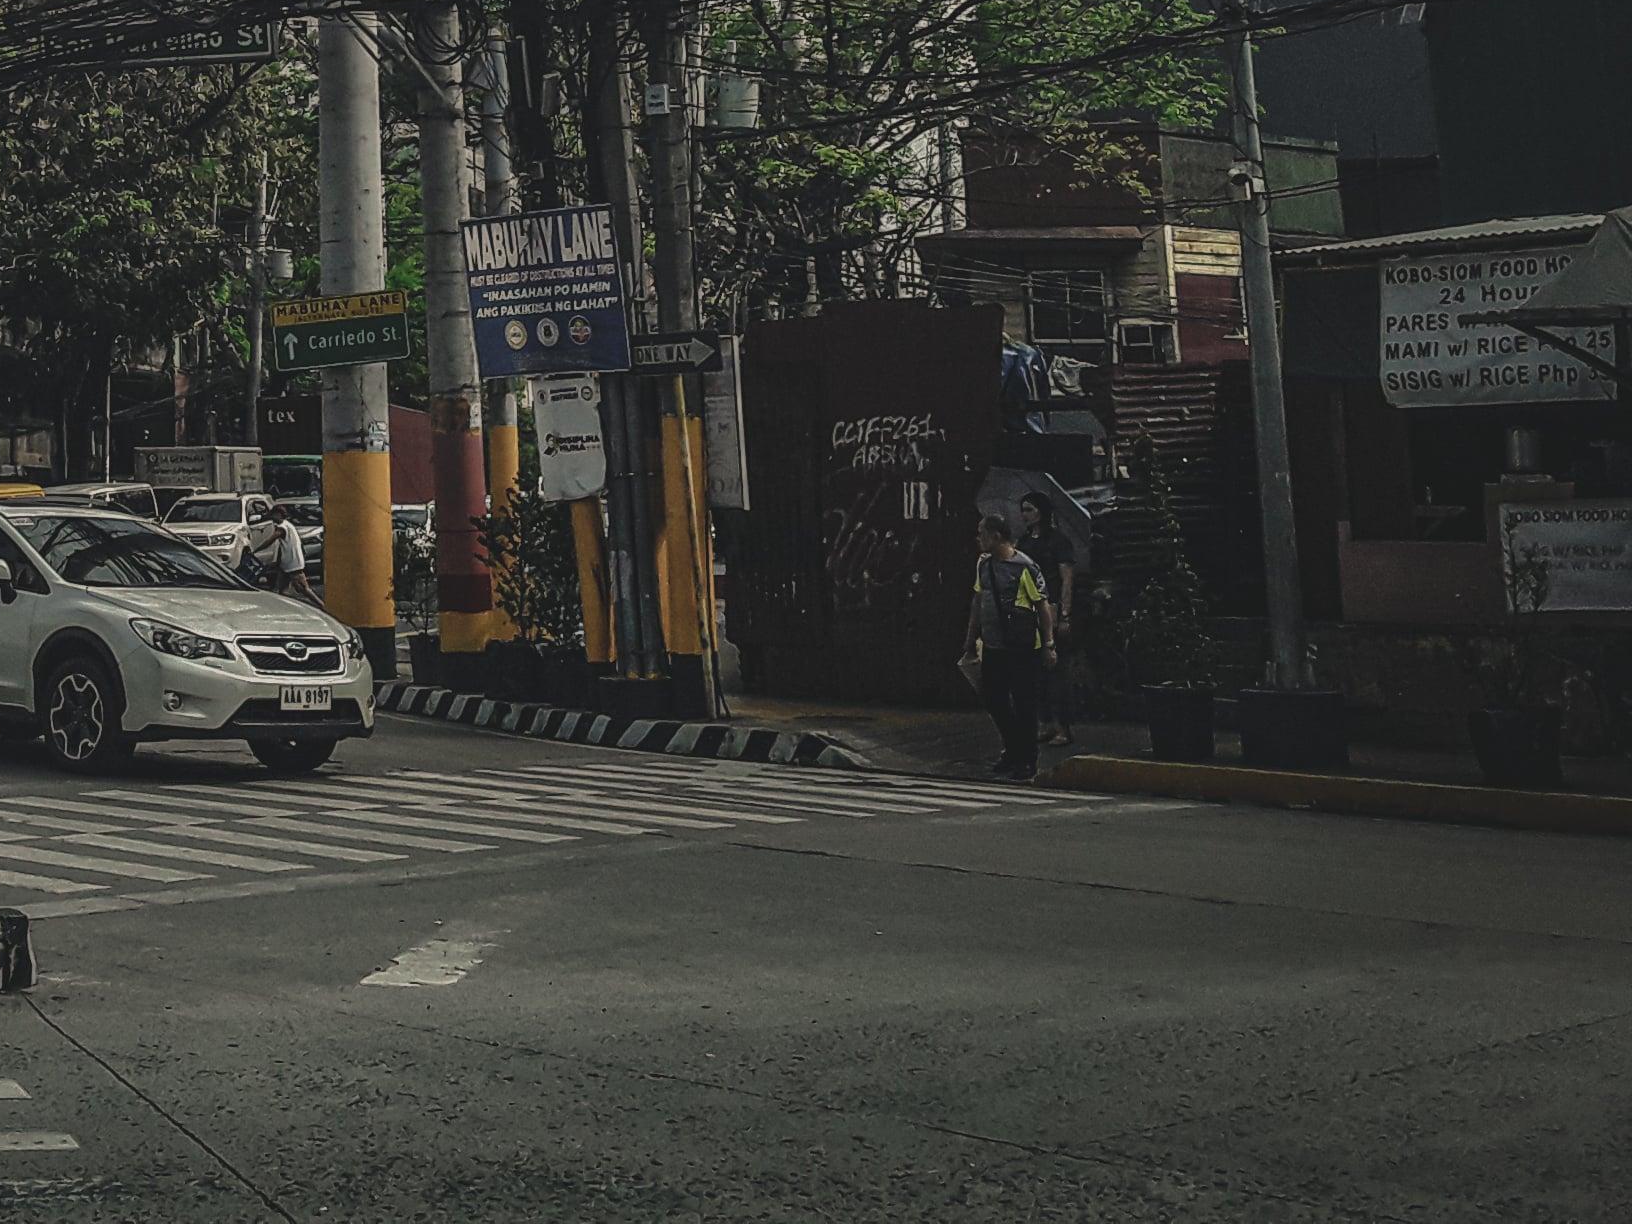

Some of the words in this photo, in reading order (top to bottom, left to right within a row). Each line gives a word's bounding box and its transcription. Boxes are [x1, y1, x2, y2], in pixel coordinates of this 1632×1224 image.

[237, 24, 264, 47] St
[464, 215, 554, 272] MABUHAY
[557, 210, 614, 262] LANE
[1385, 263, 1482, 284] KOBO-SIOM
[1489, 259, 1537, 278] FOOD
[554, 285, 569, 297] PO
[572, 281, 611, 294] NAMIN
[1439, 287, 1465, 305] 24
[276, 300, 350, 317] MABUHAY
[360, 294, 401, 308] LANE
[476, 305, 499, 318] ANG
[555, 301, 572, 312] NG
[1386, 313, 1449, 333] PARES
[308, 328, 376, 349] Carriedo
[382, 326, 402, 342] St.
[1385, 341, 1439, 360] MAMI
[1448, 339, 1468, 356] w/
[1477, 336, 1528, 355] RICE
[1586, 330, 1611, 349] 25
[1387, 371, 1442, 391] SISIG
[1449, 369, 1470, 387] w/
[1479, 366, 1529, 386] RICE
[1538, 364, 1578, 387] Php
[283, 689, 302, 704] AAA
